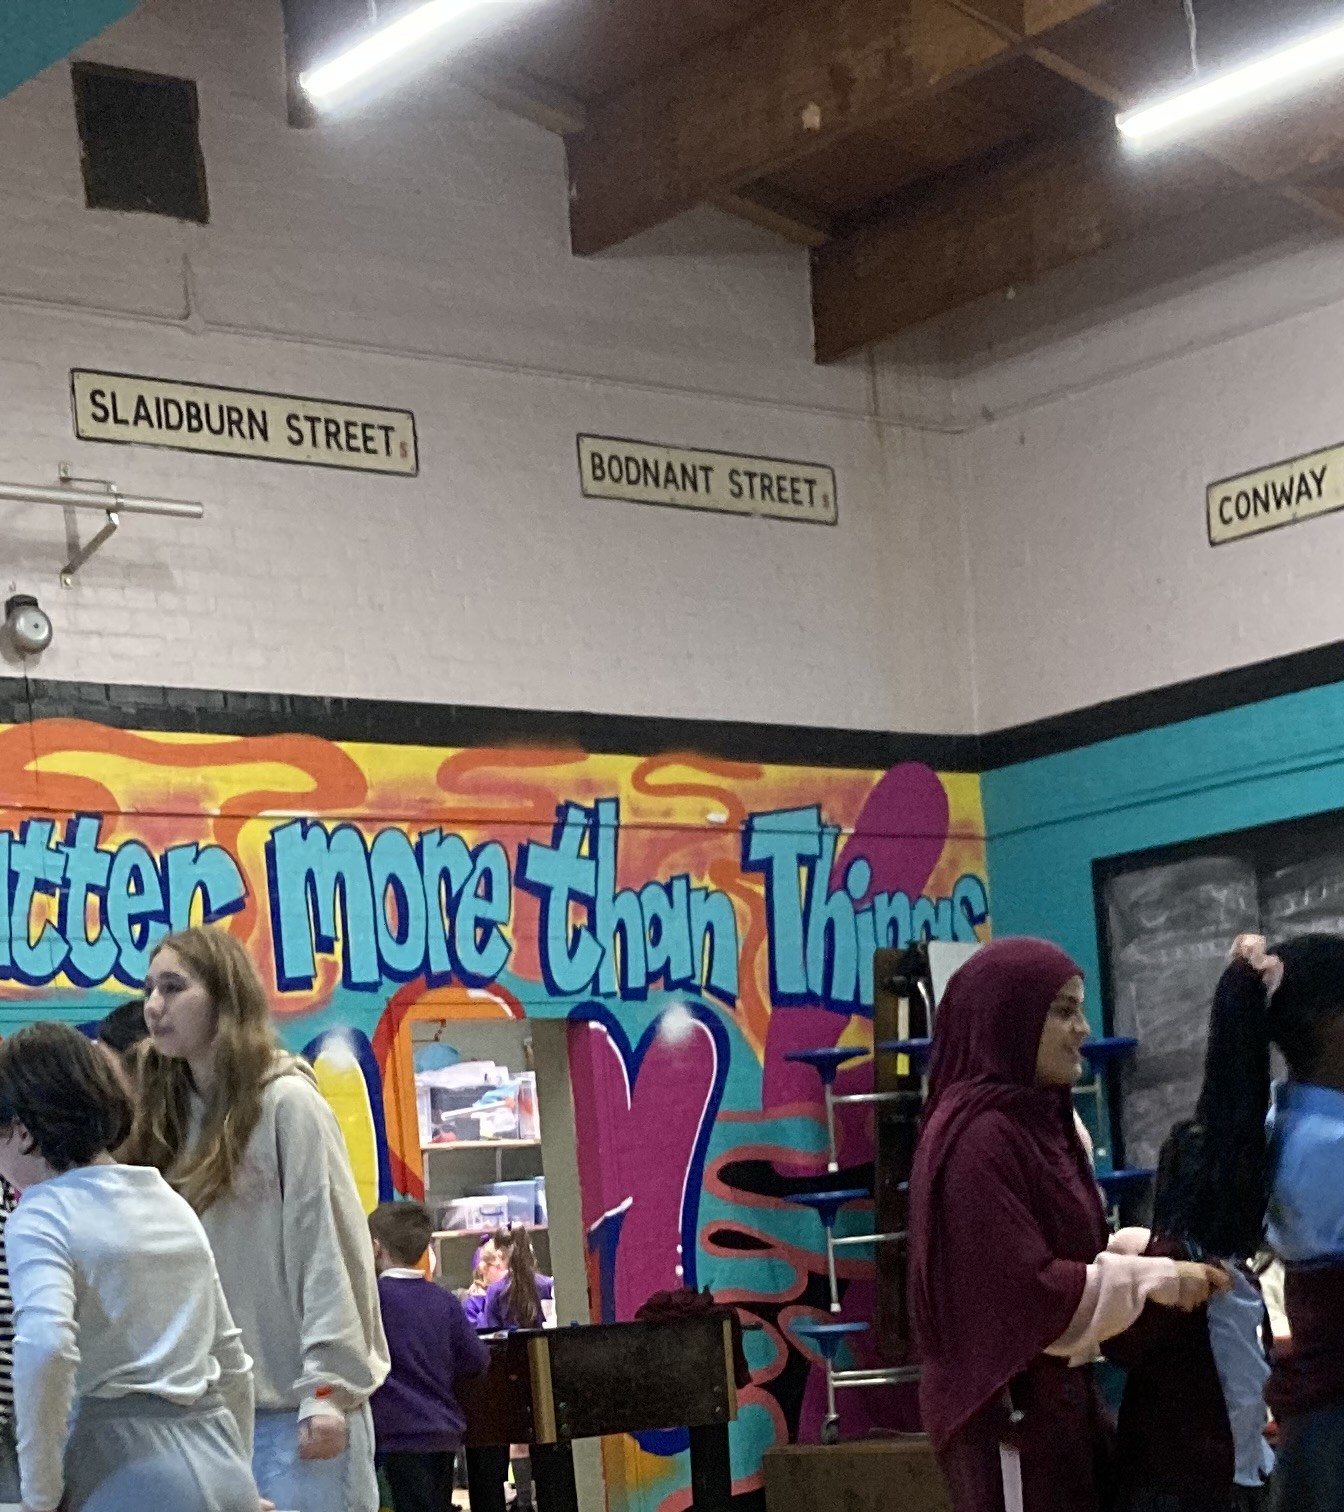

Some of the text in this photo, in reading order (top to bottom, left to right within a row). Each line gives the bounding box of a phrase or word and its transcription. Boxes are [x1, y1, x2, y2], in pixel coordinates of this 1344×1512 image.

[88, 388, 270, 443] SLAIDBURN
[286, 413, 396, 458] STREET
[590, 451, 817, 508] BODNANT STREET
[1218, 464, 1328, 526] CONWAY
[265, 816, 512, 992] more
[516, 797, 739, 1005] than
